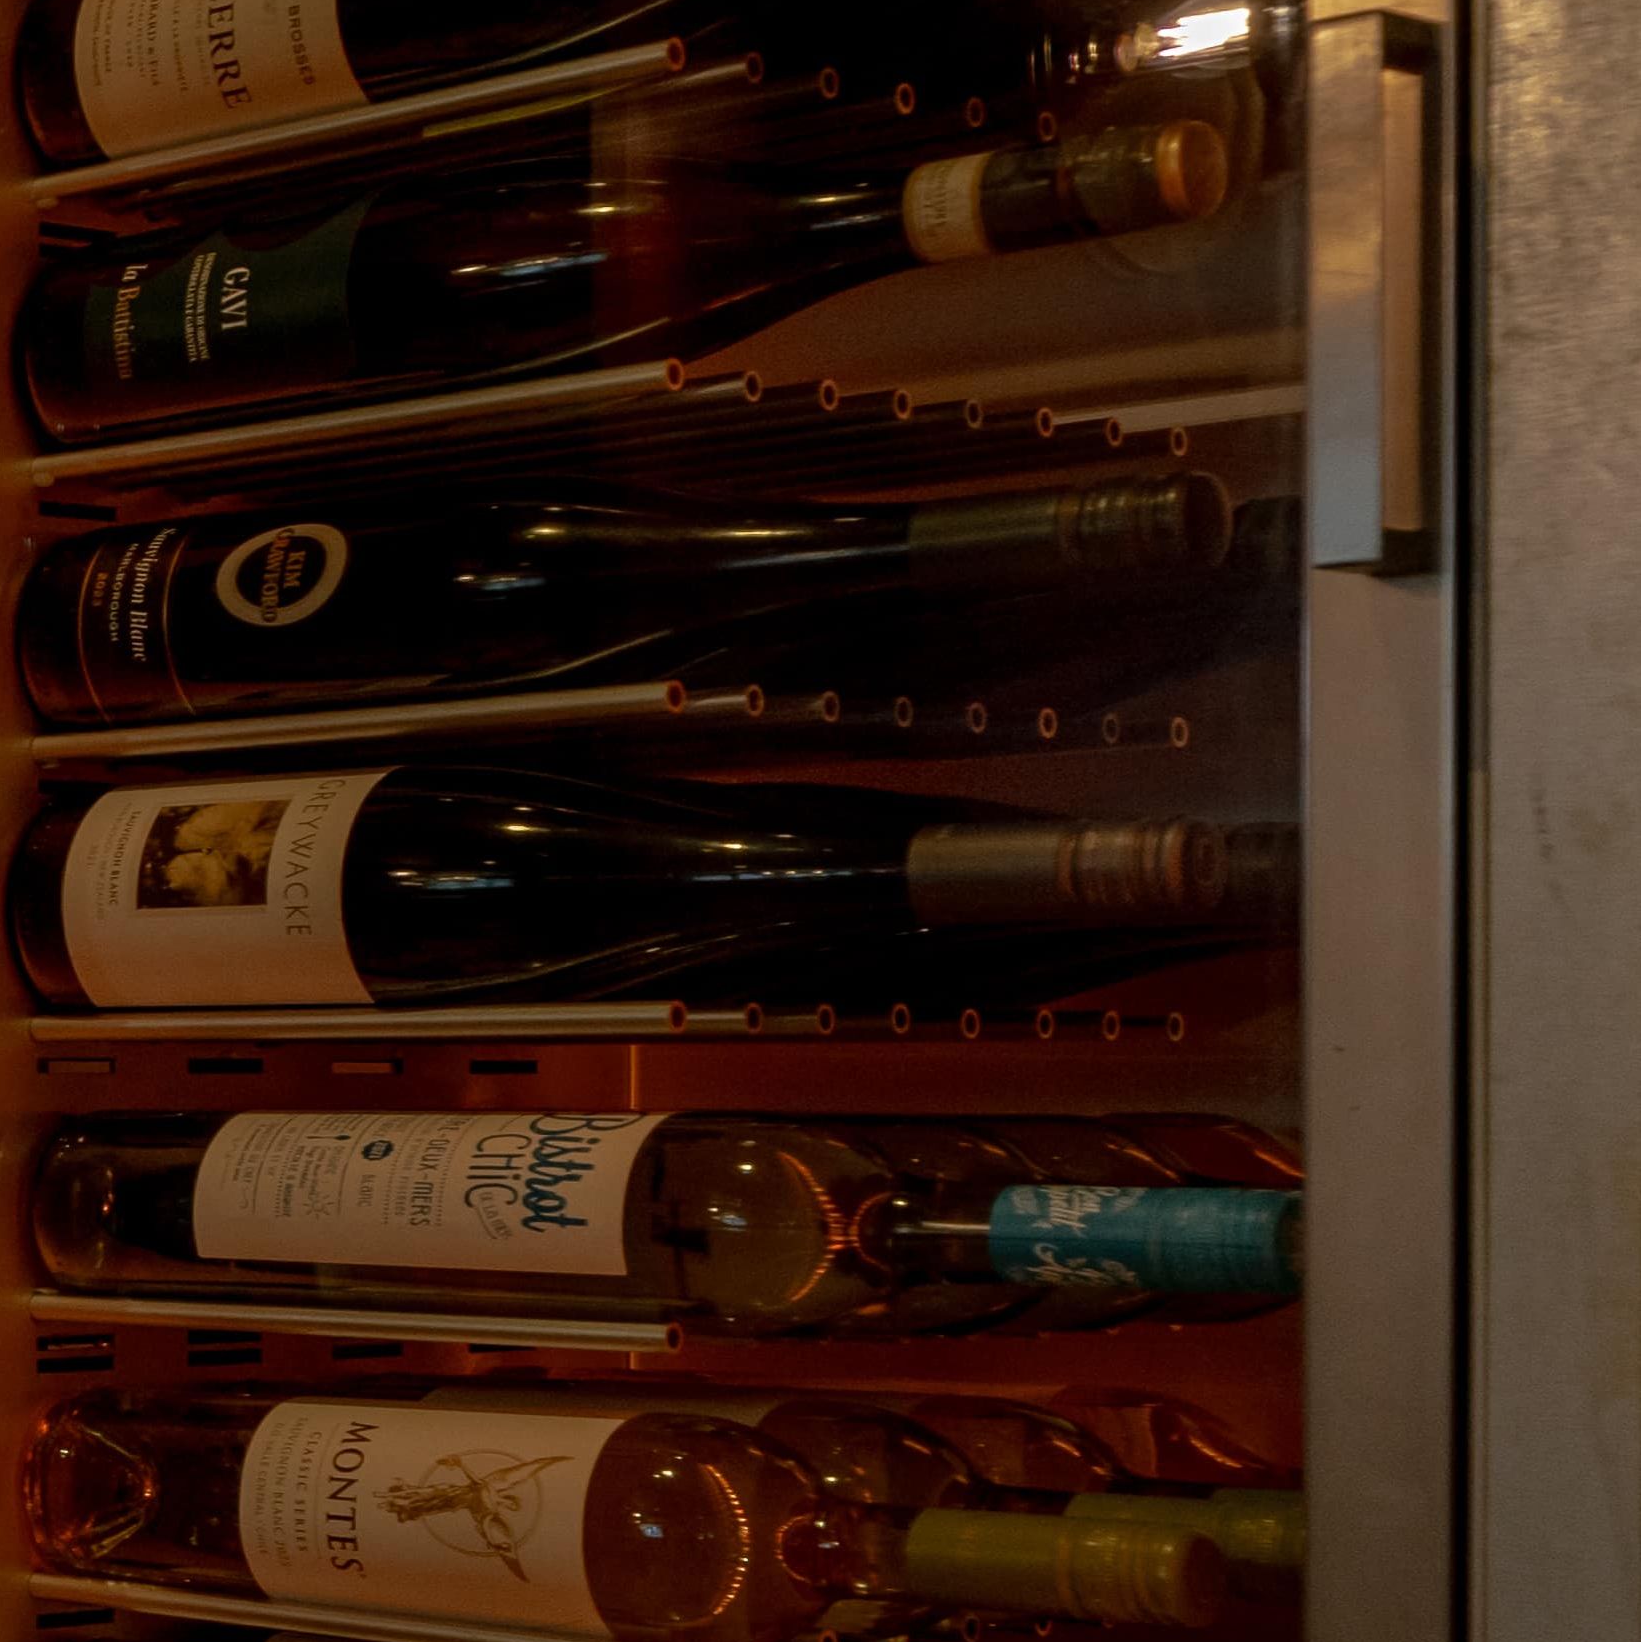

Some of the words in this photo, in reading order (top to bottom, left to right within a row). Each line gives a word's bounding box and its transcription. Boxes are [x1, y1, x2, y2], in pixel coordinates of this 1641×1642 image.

[111, 285, 142, 381] Battistina
[219, 267, 251, 331] GAVI
[128, 526, 178, 605] Sauvignon
[259, 527, 295, 623] CRAWFORD
[281, 549, 307, 589] KIM
[127, 610, 150, 663] Blanc
[282, 778, 346, 937] GREYWACKE
[522, 1112, 647, 1233] Bistrot
[295, 1431, 323, 1492] CLASSIC
[325, 1420, 380, 1573] MONTES
[293, 1499, 309, 1553] SERIES
